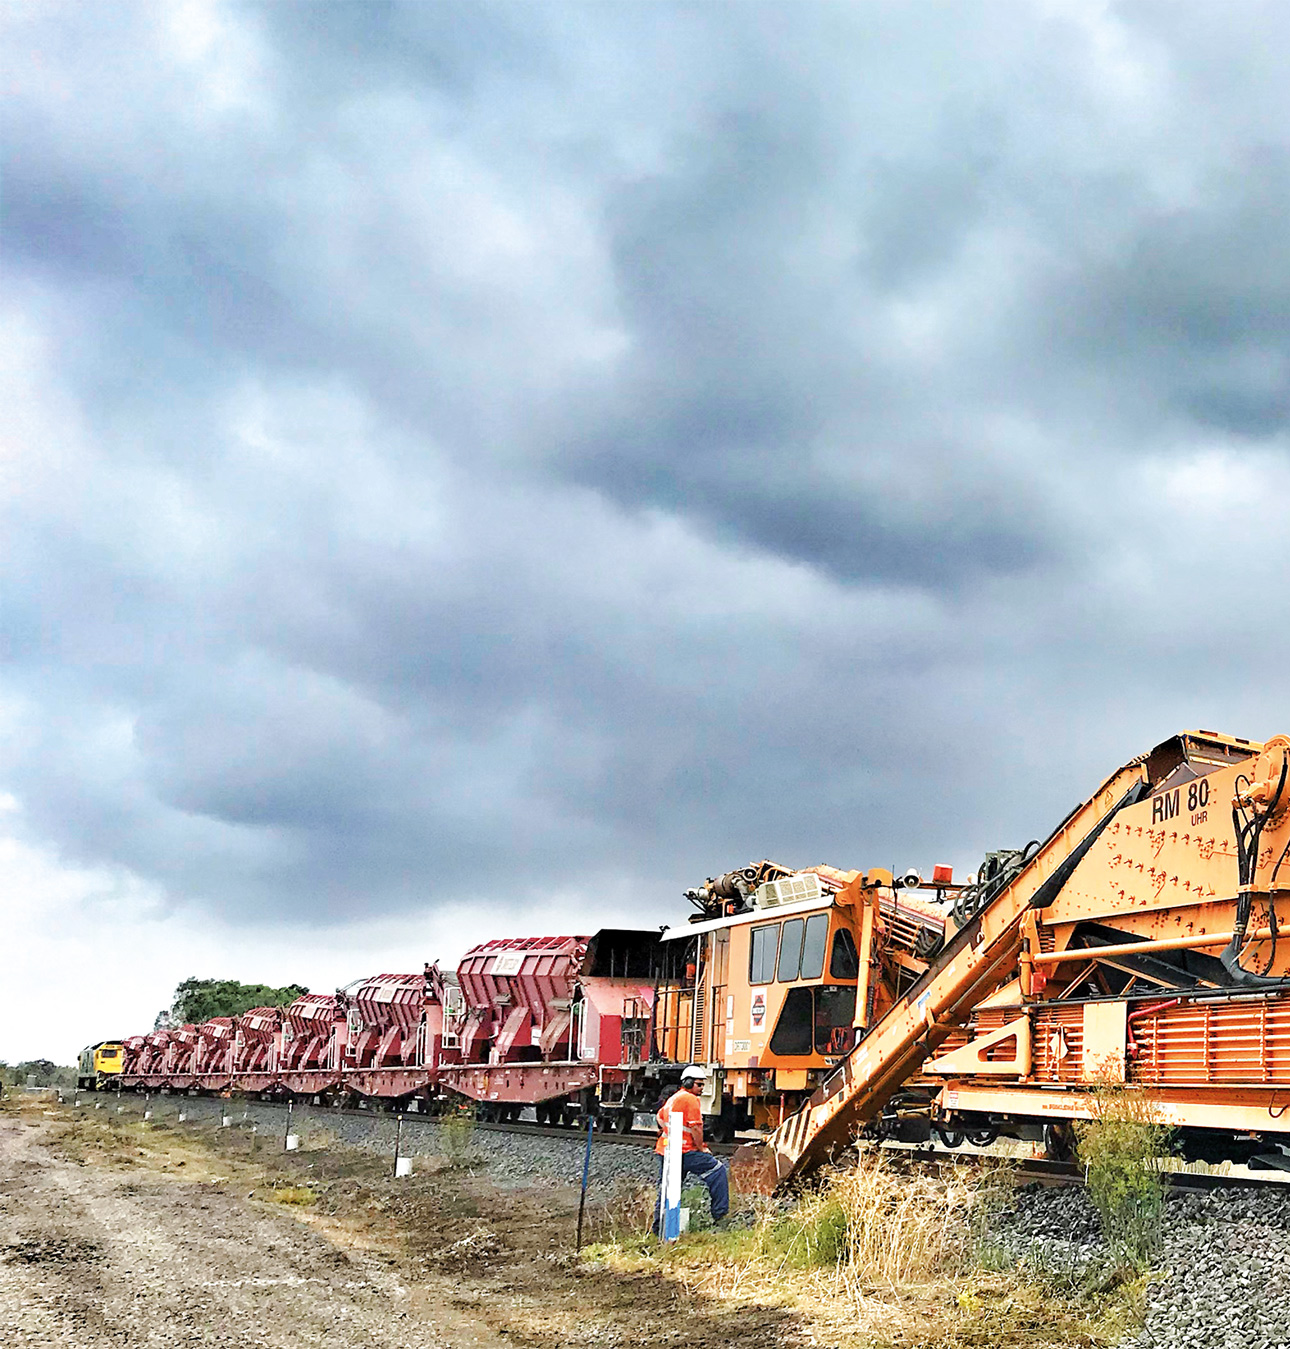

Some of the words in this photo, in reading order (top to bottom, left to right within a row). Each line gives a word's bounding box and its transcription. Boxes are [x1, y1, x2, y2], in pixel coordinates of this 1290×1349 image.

[1152, 789, 1180, 825] RM
[1188, 778, 1209, 811] 80
[1191, 810, 1208, 827] UHR
